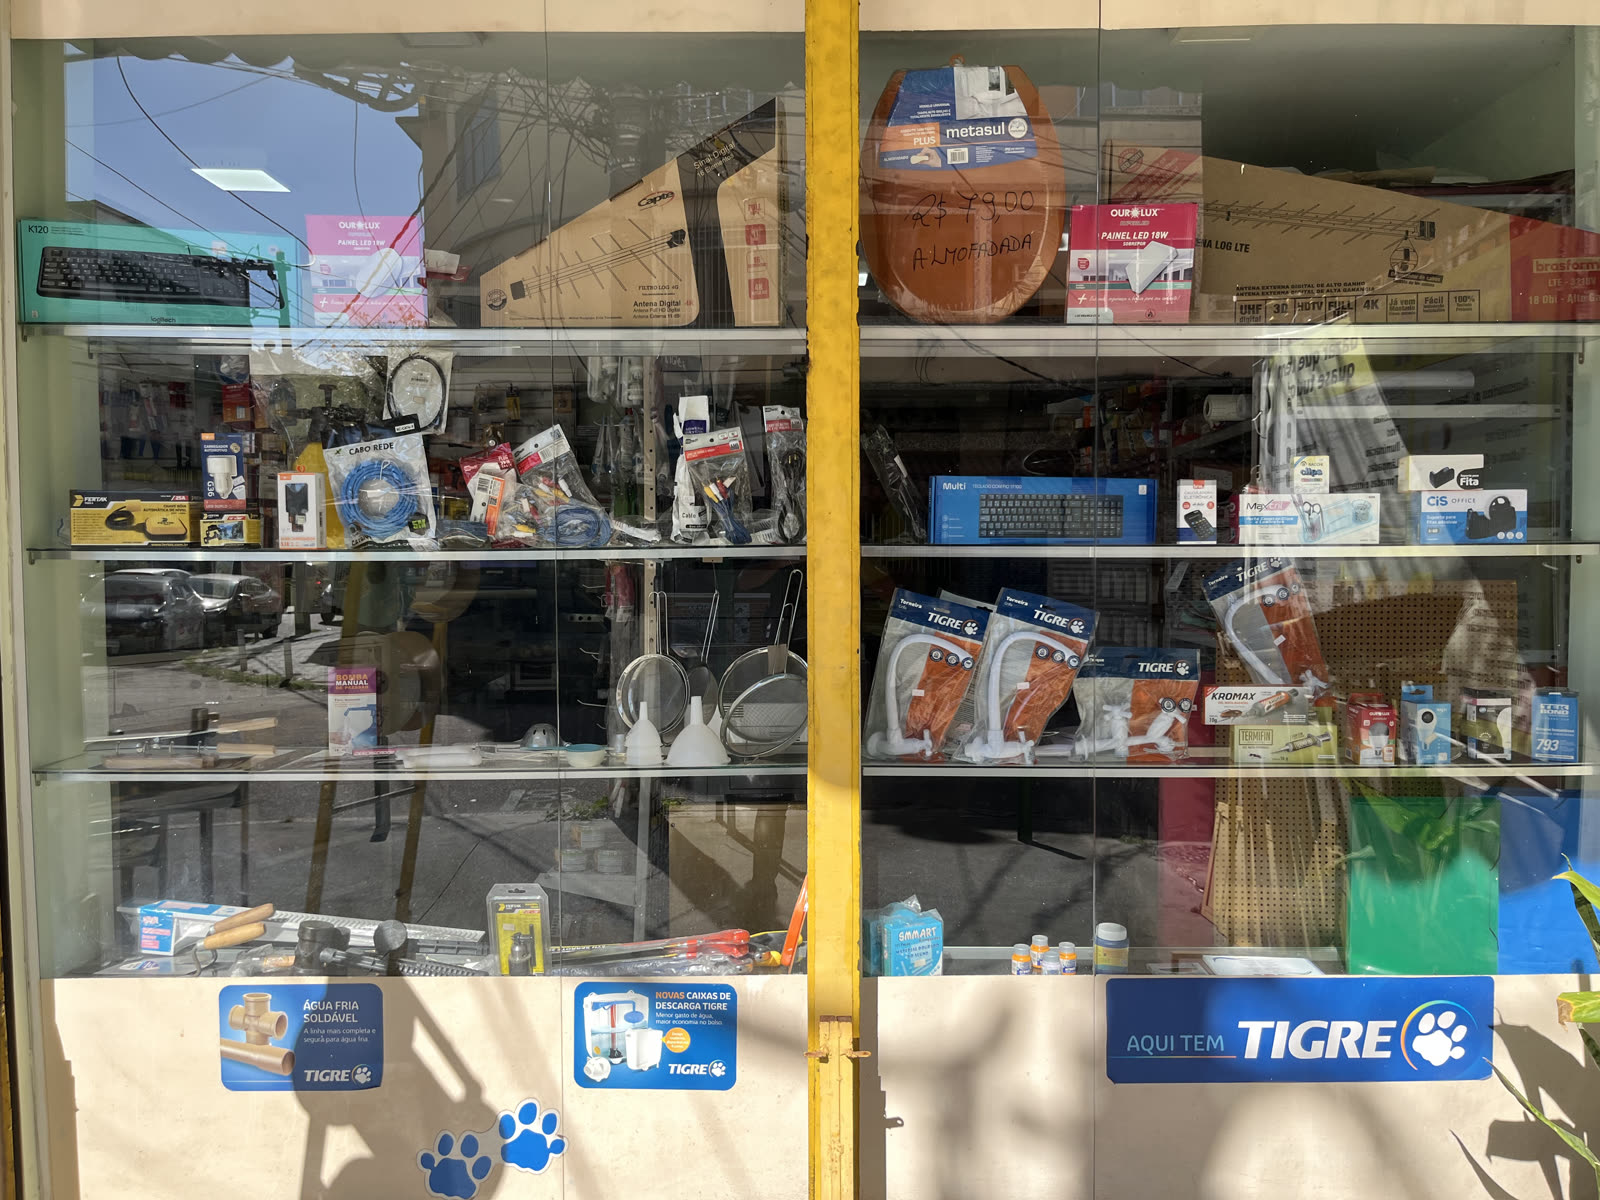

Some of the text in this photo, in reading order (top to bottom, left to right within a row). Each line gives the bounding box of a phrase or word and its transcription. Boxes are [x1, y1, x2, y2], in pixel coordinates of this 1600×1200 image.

[946, 123, 1004, 139] metasul
[914, 136, 936, 146] PLUS
[957, 191, 1034, 225] 79,00
[28, 226, 48, 234] K120
[1101, 231, 1168, 240] PAINEL LED 18W
[1214, 240, 1233, 250] LOG
[1234, 242, 1250, 253] LTE
[913, 234, 1032, 272] ALMOFADADA
[659, 300, 680, 308] Digital
[1328, 300, 1353, 310] FULL
[1363, 299, 1380, 310] 4K
[1424, 296, 1444, 304] Fácil
[1240, 304, 1262, 316] UHF
[1274, 304, 1288, 314] 3D
[1297, 302, 1323, 312] HDTV
[349, 442, 394, 456] CABO REDE
[942, 482, 966, 490] Multi
[1460, 477, 1480, 486] Fita
[207, 481, 215, 498] G36
[1208, 562, 1268, 586] Torneira TIGRE
[900, 598, 963, 630] Torneira TIGRE
[1006, 596, 1070, 628] Torneira TIGRE
[1138, 662, 1174, 672] TIGRE
[1211, 692, 1256, 700] KROMAX
[1241, 730, 1271, 741] TERMIFIN
[1536, 738, 1560, 751] 793
[898, 926, 936, 942] SMMART
[655, 992, 732, 1000] NOVAS CAIXAS DE
[304, 999, 359, 1010] ÁGUA FRIA
[655, 1002, 728, 1010] DESCARGA TIGRE
[304, 1010, 358, 1023] SOLDÁVEL
[342, 1028, 370, 1036] completa
[341, 1035, 357, 1044] água
[1127, 1020, 1397, 1060] AQUI TEM TIGRE
[668, 1063, 708, 1075] TIGRE
[304, 1069, 350, 1082] TIGRE
